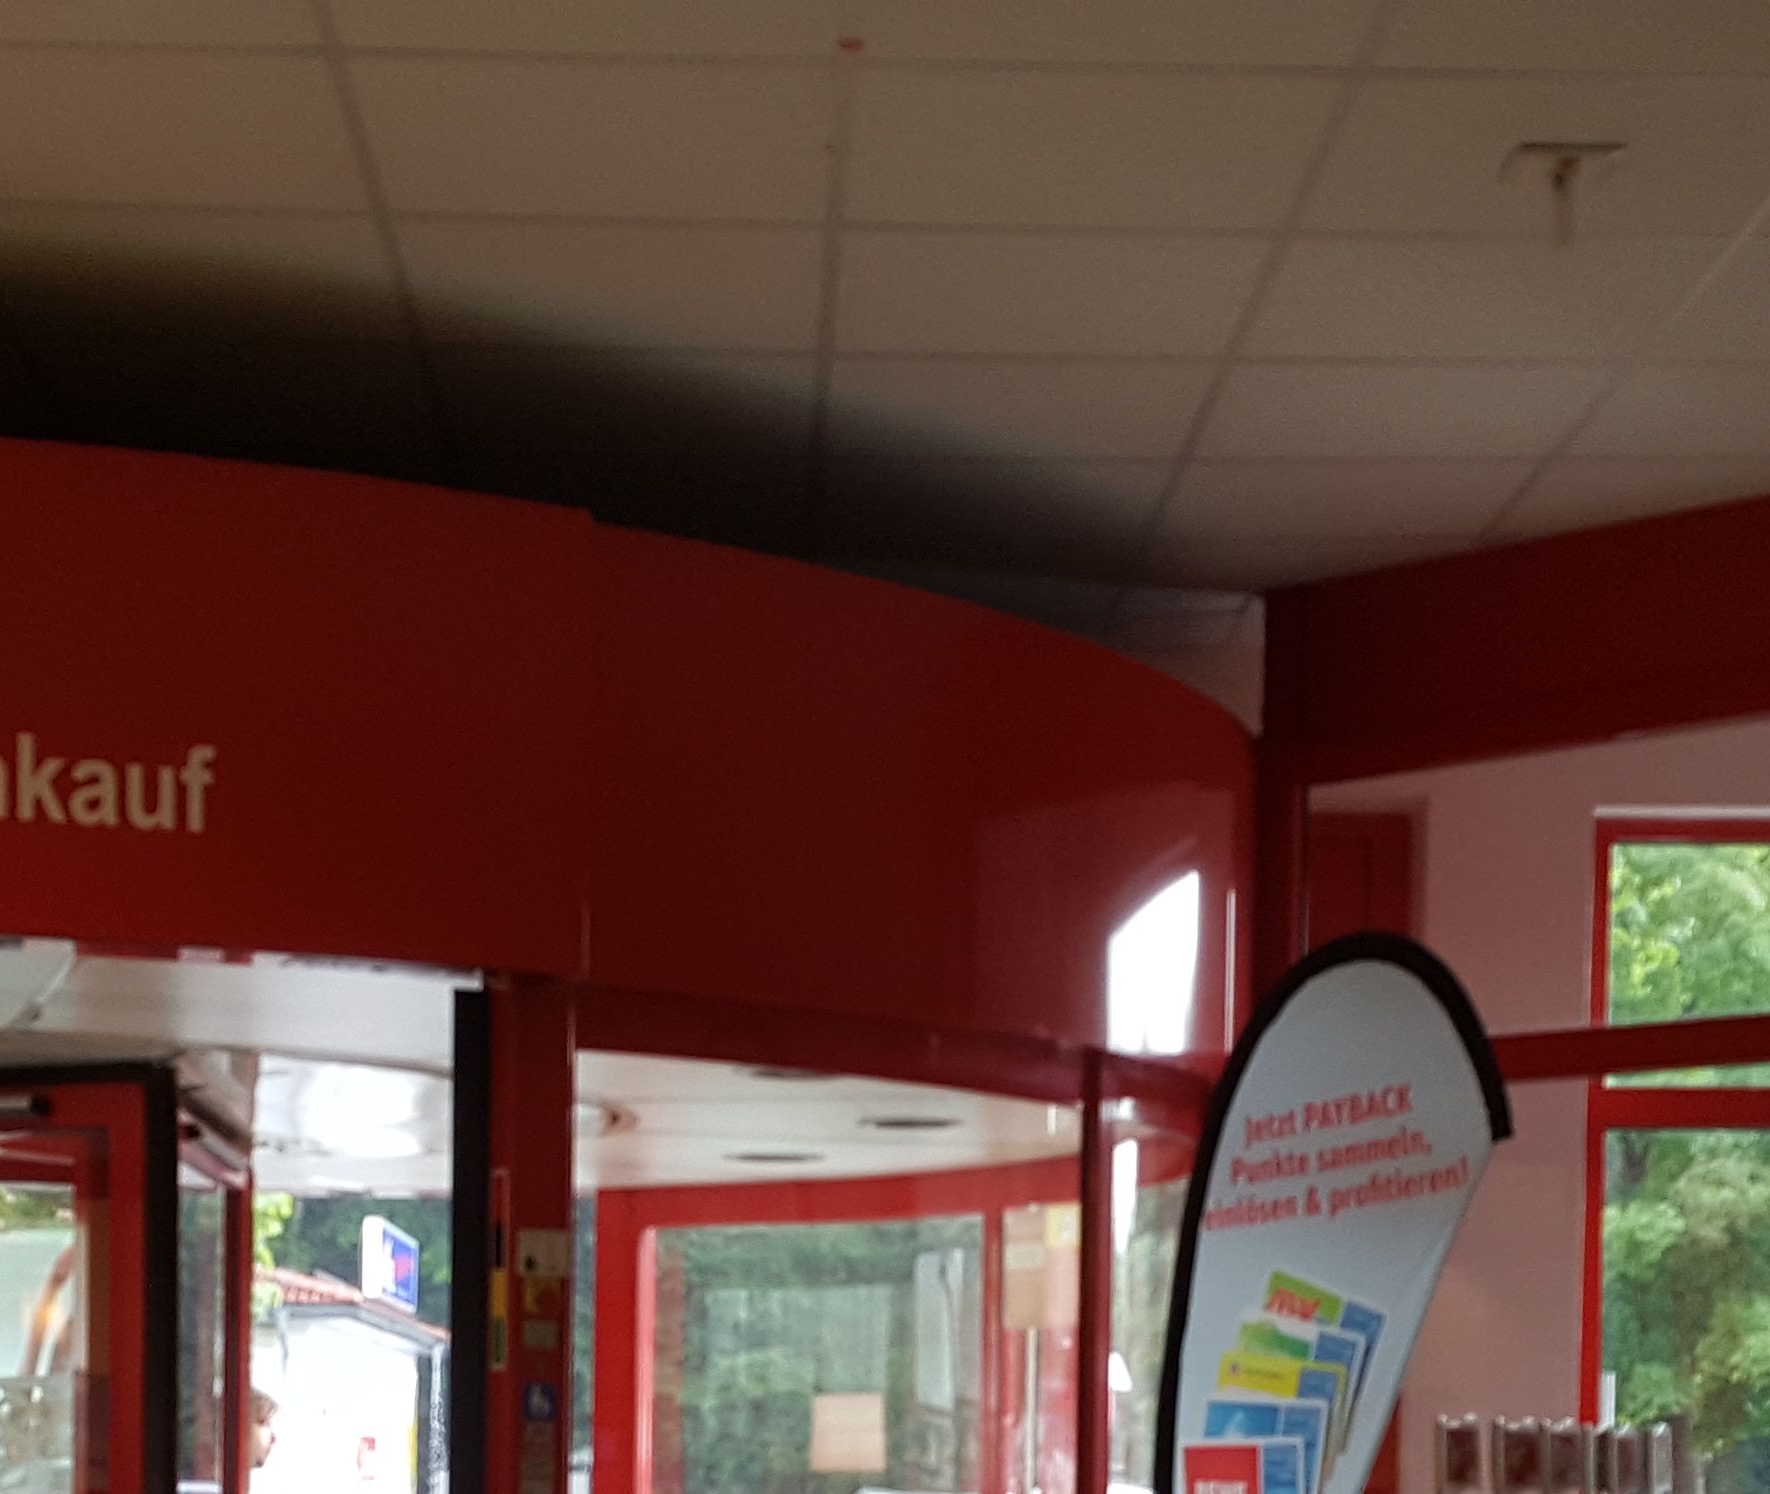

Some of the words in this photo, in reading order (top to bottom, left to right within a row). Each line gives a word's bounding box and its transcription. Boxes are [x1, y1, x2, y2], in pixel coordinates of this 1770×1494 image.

[1245, 1109, 1296, 1149] Jetzt
[1302, 1083, 1413, 1132] PAYBACK
[1231, 1153, 1309, 1186] Punkte
[1316, 1128, 1434, 1172] sammeln,
[1204, 1195, 1298, 1231] einlösen
[1303, 1187, 1321, 1216] &
[1328, 1156, 1468, 1217] profitieren!
